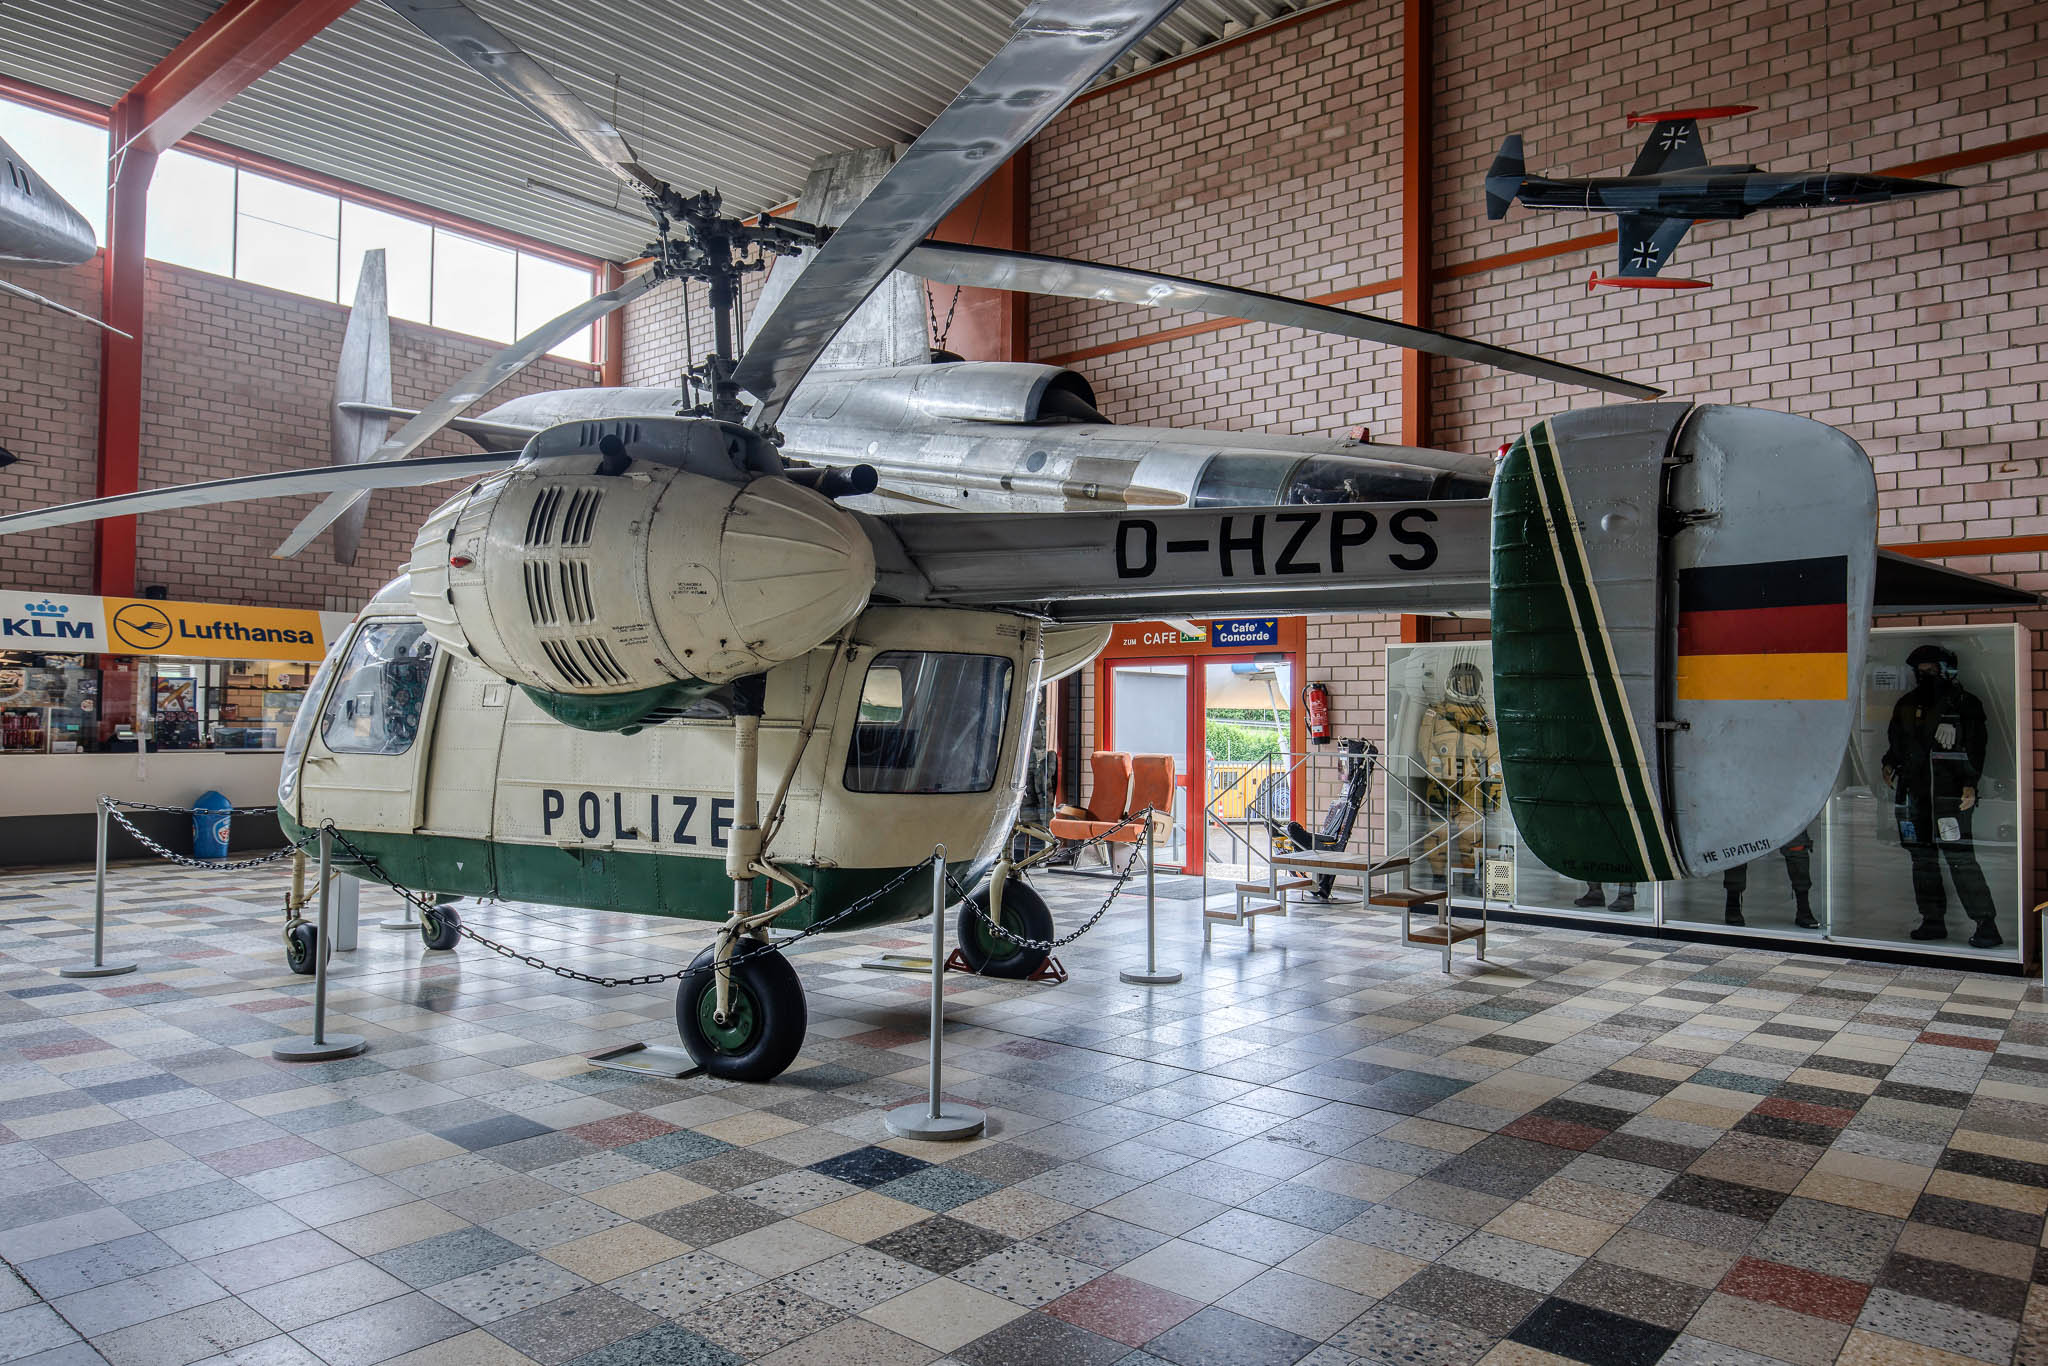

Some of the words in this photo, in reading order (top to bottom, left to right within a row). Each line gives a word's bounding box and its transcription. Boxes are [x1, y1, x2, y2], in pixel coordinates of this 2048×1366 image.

[1115, 508, 1439, 579] D-HZPS
[3, 618, 95, 639] KLM
[179, 618, 314, 645] Lufthansa
[1143, 631, 1177, 645] CAFE
[1220, 632, 1270, 642] Concorde
[542, 789, 760, 849] POLIZE
